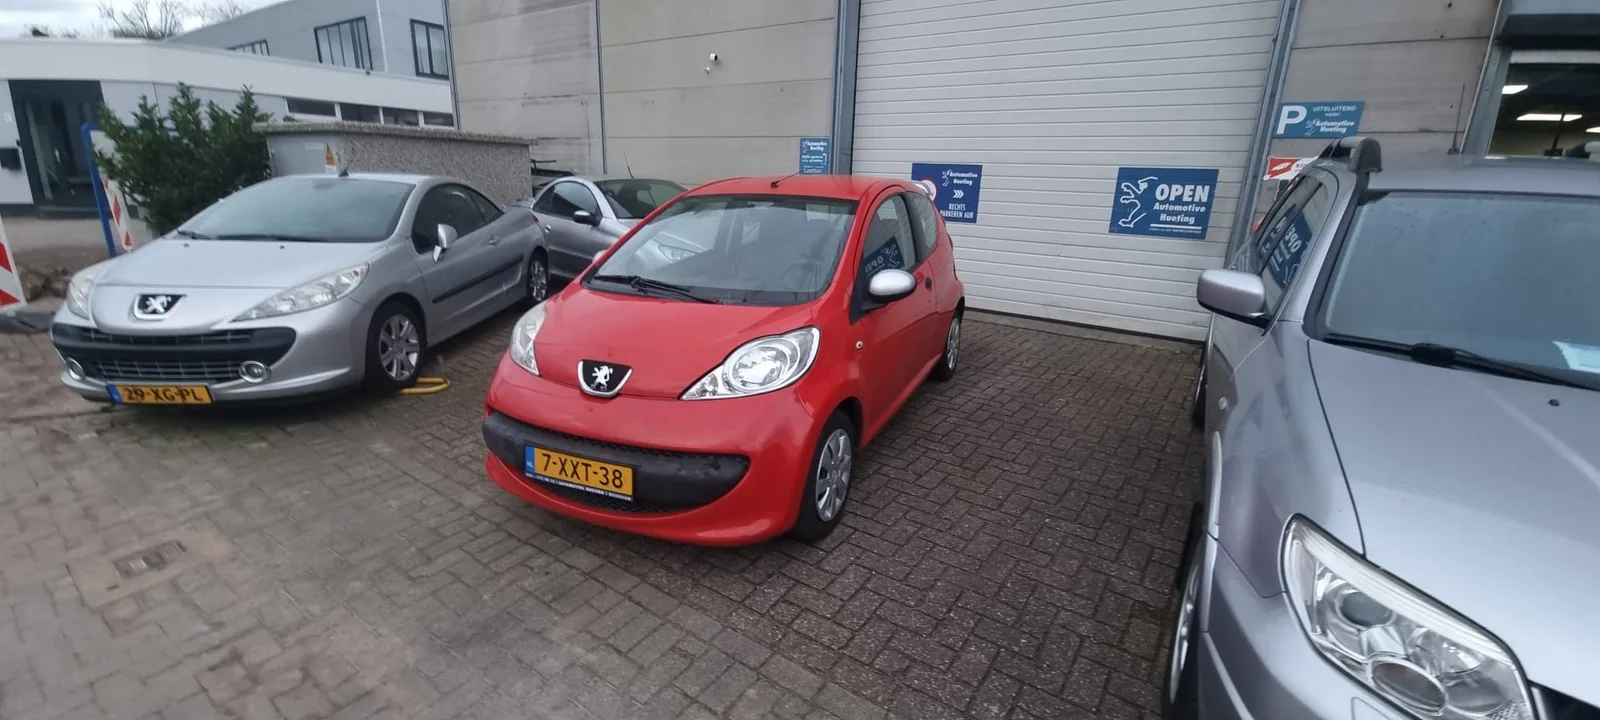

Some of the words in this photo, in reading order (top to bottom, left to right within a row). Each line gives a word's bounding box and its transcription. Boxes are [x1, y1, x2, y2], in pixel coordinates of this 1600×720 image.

[1276, 105, 1307, 135] P
[1320, 126, 1347, 134] Hueting
[1155, 183, 1210, 203] OPEN
[948, 203, 966, 211] RECHTS
[1153, 202, 1206, 213] Automotive
[940, 210, 963, 218] PARKEREN
[1160, 213, 1195, 225] Hueting
[123, 386, 204, 402] 29-XG-PL
[542, 452, 623, 489] 7-XXT-38
